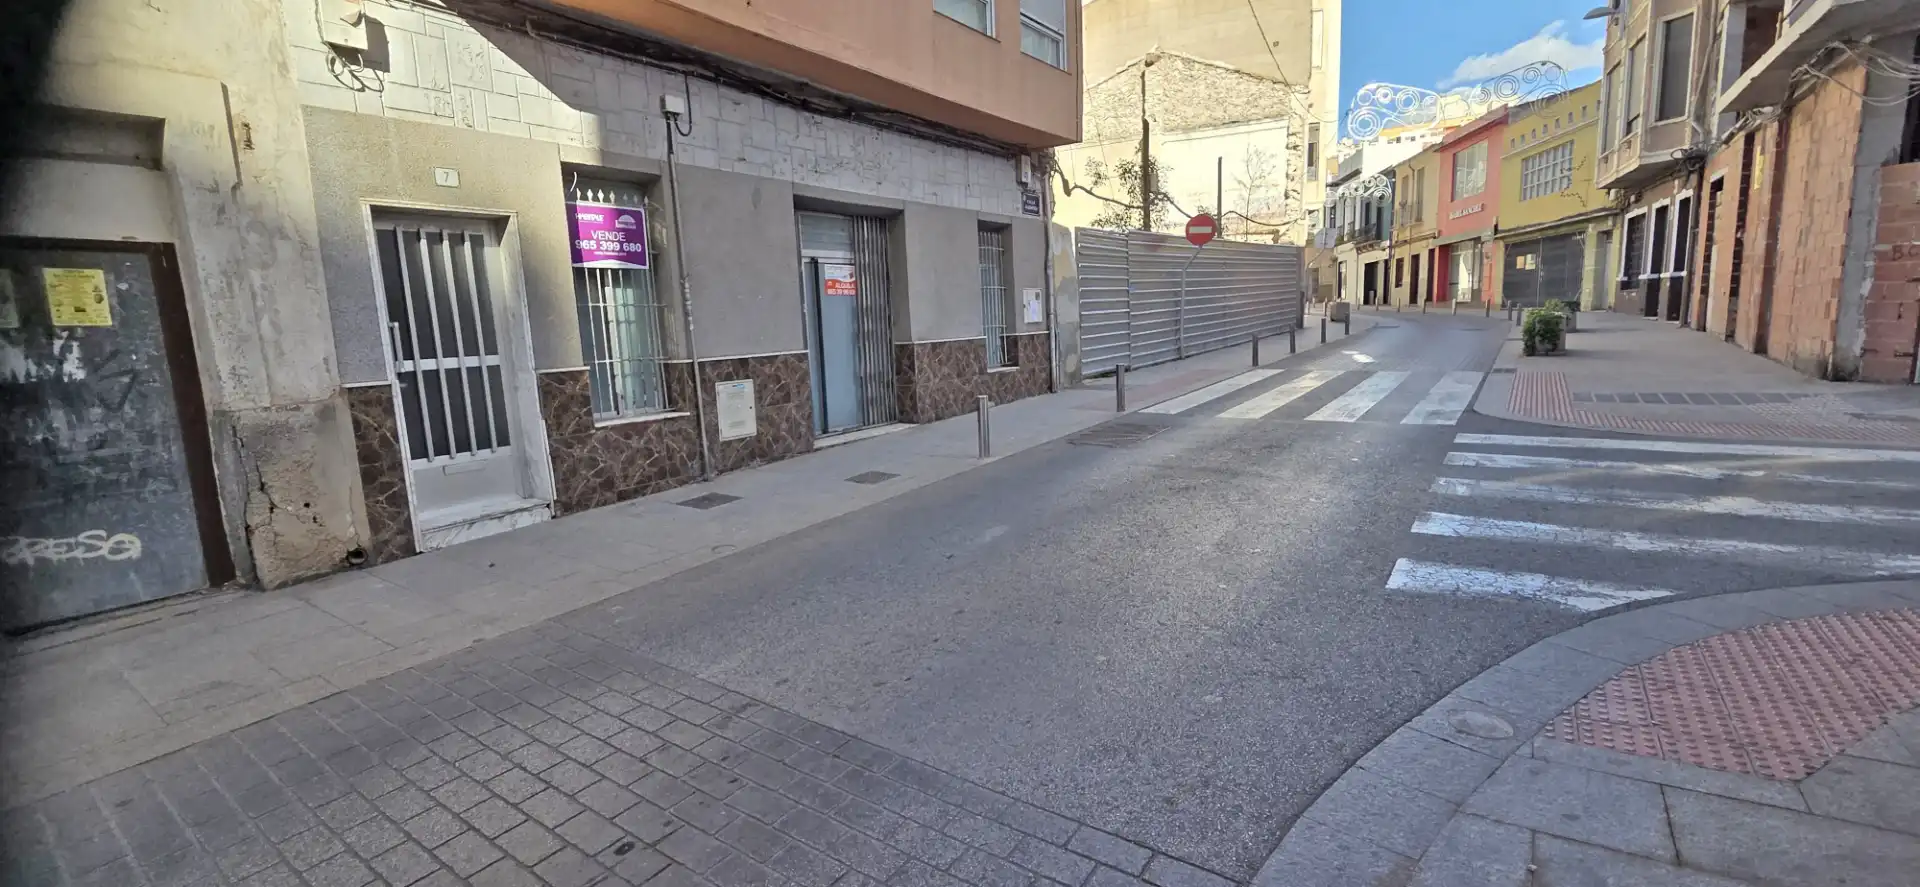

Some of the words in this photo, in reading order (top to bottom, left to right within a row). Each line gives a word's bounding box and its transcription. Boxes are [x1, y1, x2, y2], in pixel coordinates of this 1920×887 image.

[443, 171, 449, 183] 7
[590, 230, 627, 241] VENDE
[575, 240, 597, 250] 965
[600, 241, 620, 251] 399
[623, 243, 642, 252] 680
